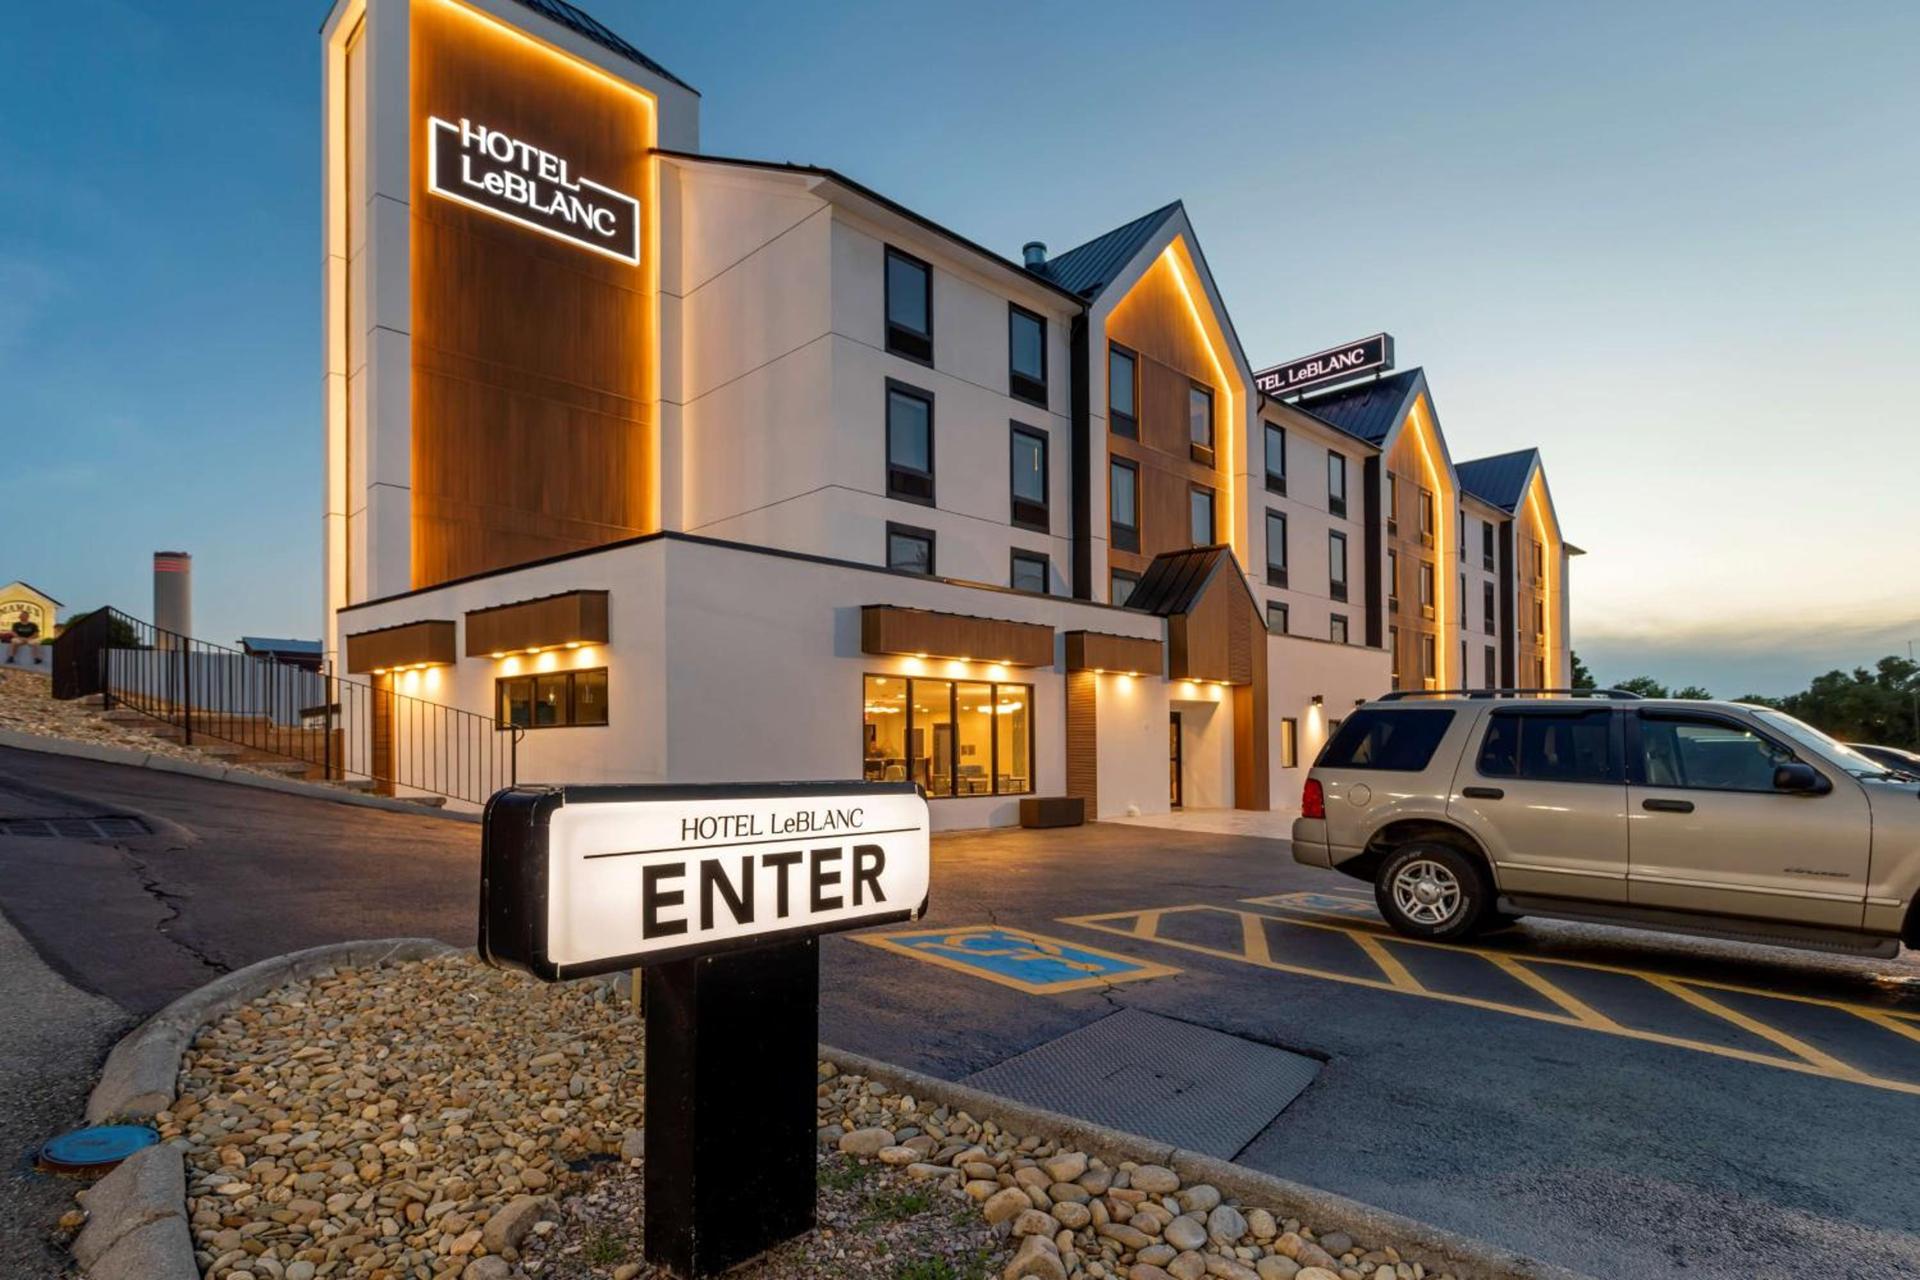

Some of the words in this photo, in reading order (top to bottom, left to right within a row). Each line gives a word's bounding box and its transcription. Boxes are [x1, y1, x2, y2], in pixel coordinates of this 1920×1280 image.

[460, 118, 580, 191] HOTEL
[461, 154, 616, 236] LeBLANC
[1288, 348, 1365, 383] LeBLANC
[681, 814, 763, 841] HOTEL
[771, 808, 864, 834] LeBLANC
[642, 843, 888, 940] ENTER
